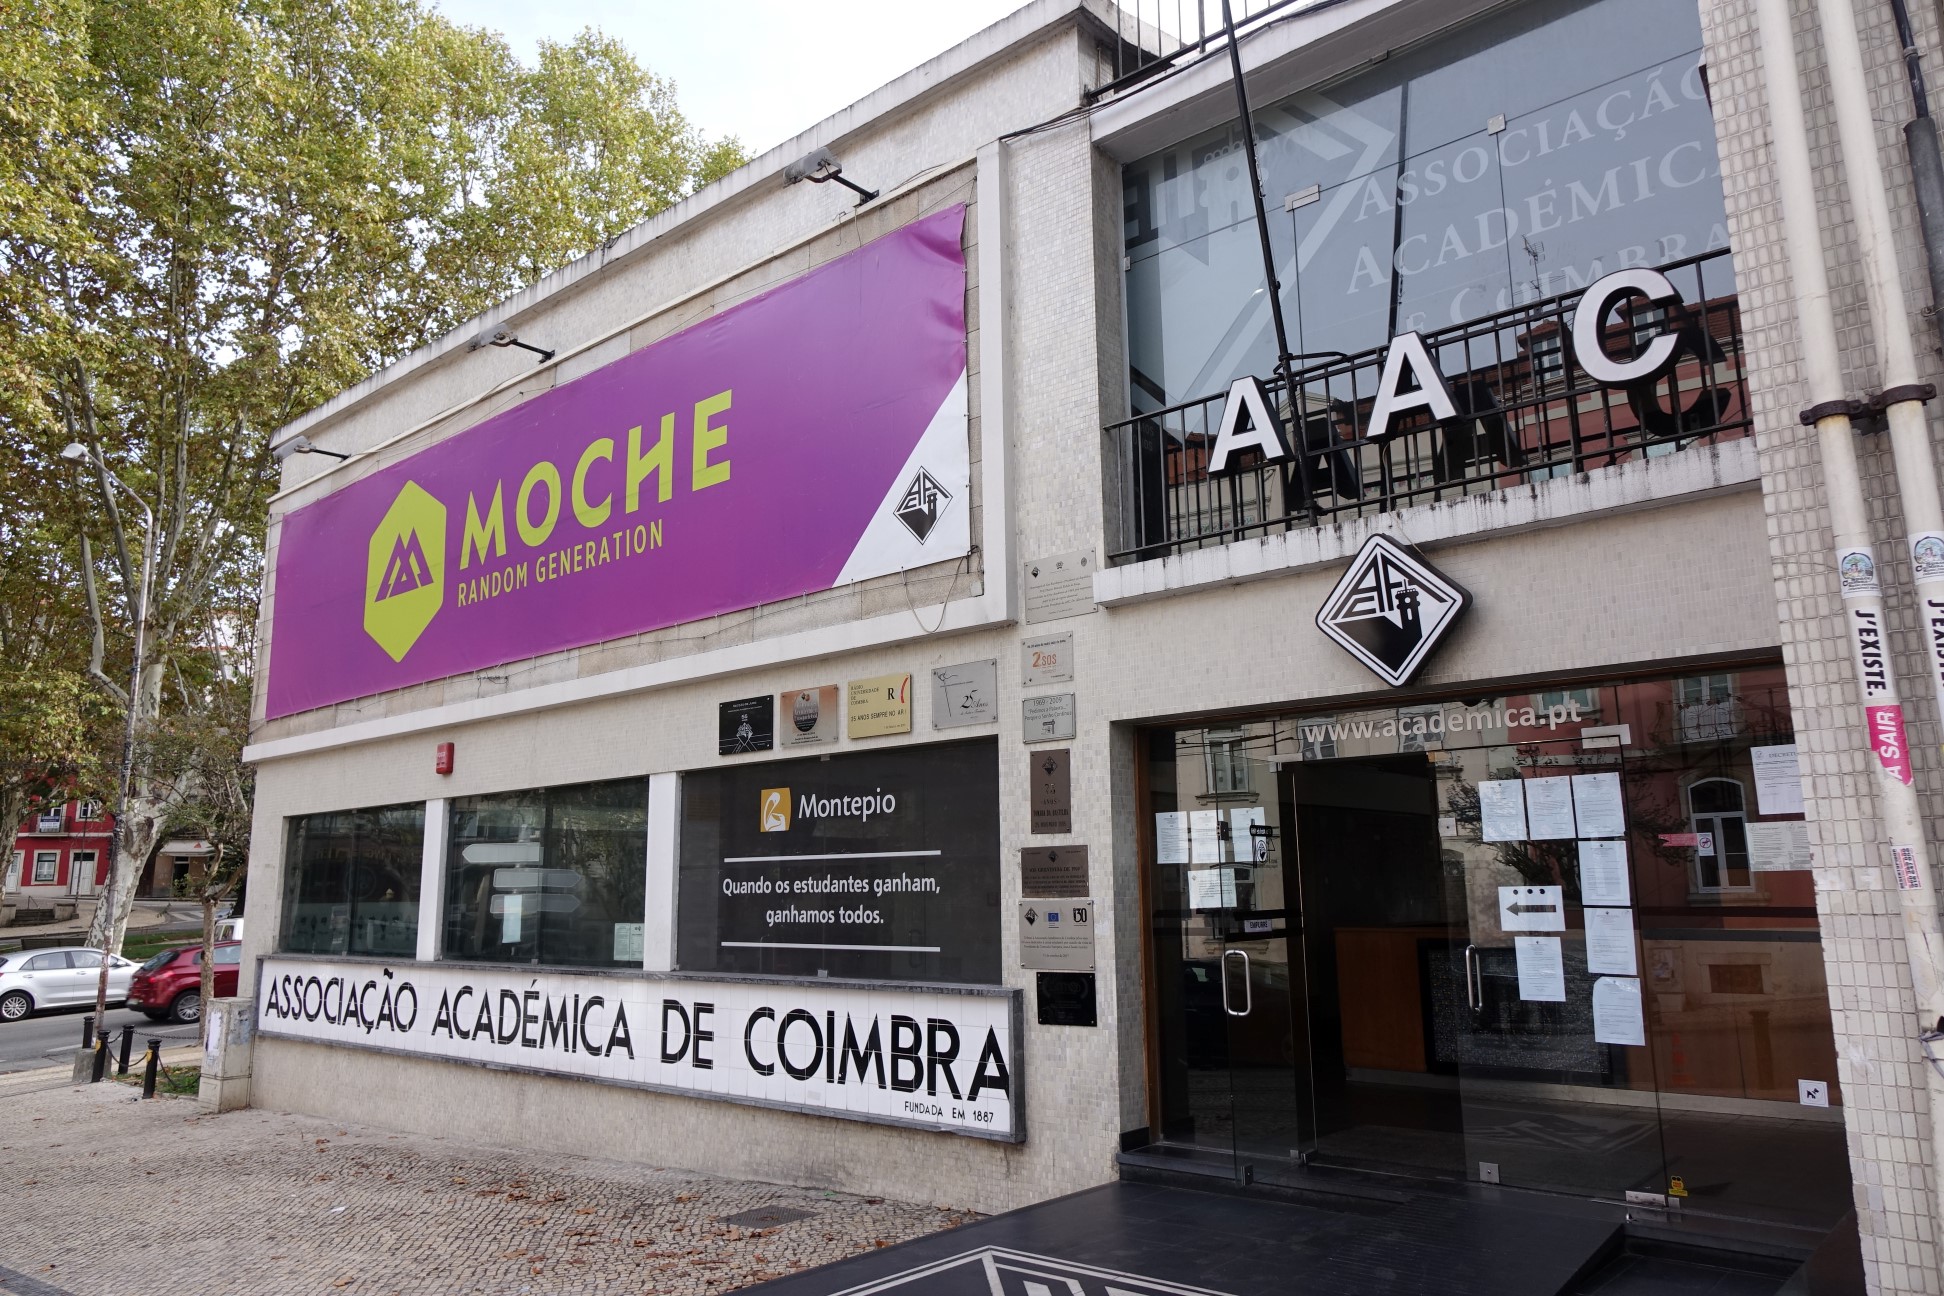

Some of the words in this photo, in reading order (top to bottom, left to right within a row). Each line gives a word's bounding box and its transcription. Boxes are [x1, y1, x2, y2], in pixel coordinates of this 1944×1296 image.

[1346, 140, 1732, 294] ACADÉMIC
[459, 389, 732, 570] MOCHE
[458, 562, 528, 607] RANDOM
[535, 519, 663, 583] GENERATION
[1305, 699, 1581, 742] www.academica.pt
[1876, 711, 1900, 759] SAIR
[799, 788, 896, 822] Montepio
[722, 876, 772, 896] Quando
[775, 880, 790, 894] os
[793, 875, 869, 893] estudantes
[873, 872, 941, 897] ganham,
[766, 905, 835, 927] ganhamos
[839, 904, 884, 924] todos.
[265, 968, 417, 1034] ASSOCIAÇÃO
[432, 978, 635, 1060] ACADÉMICA
[660, 998, 715, 1070] DE
[744, 1006, 1010, 1102] COIMBRA
[904, 1100, 944, 1117] FUNDADA
[952, 1108, 966, 1121] EM
[972, 1110, 994, 1124] 1887
